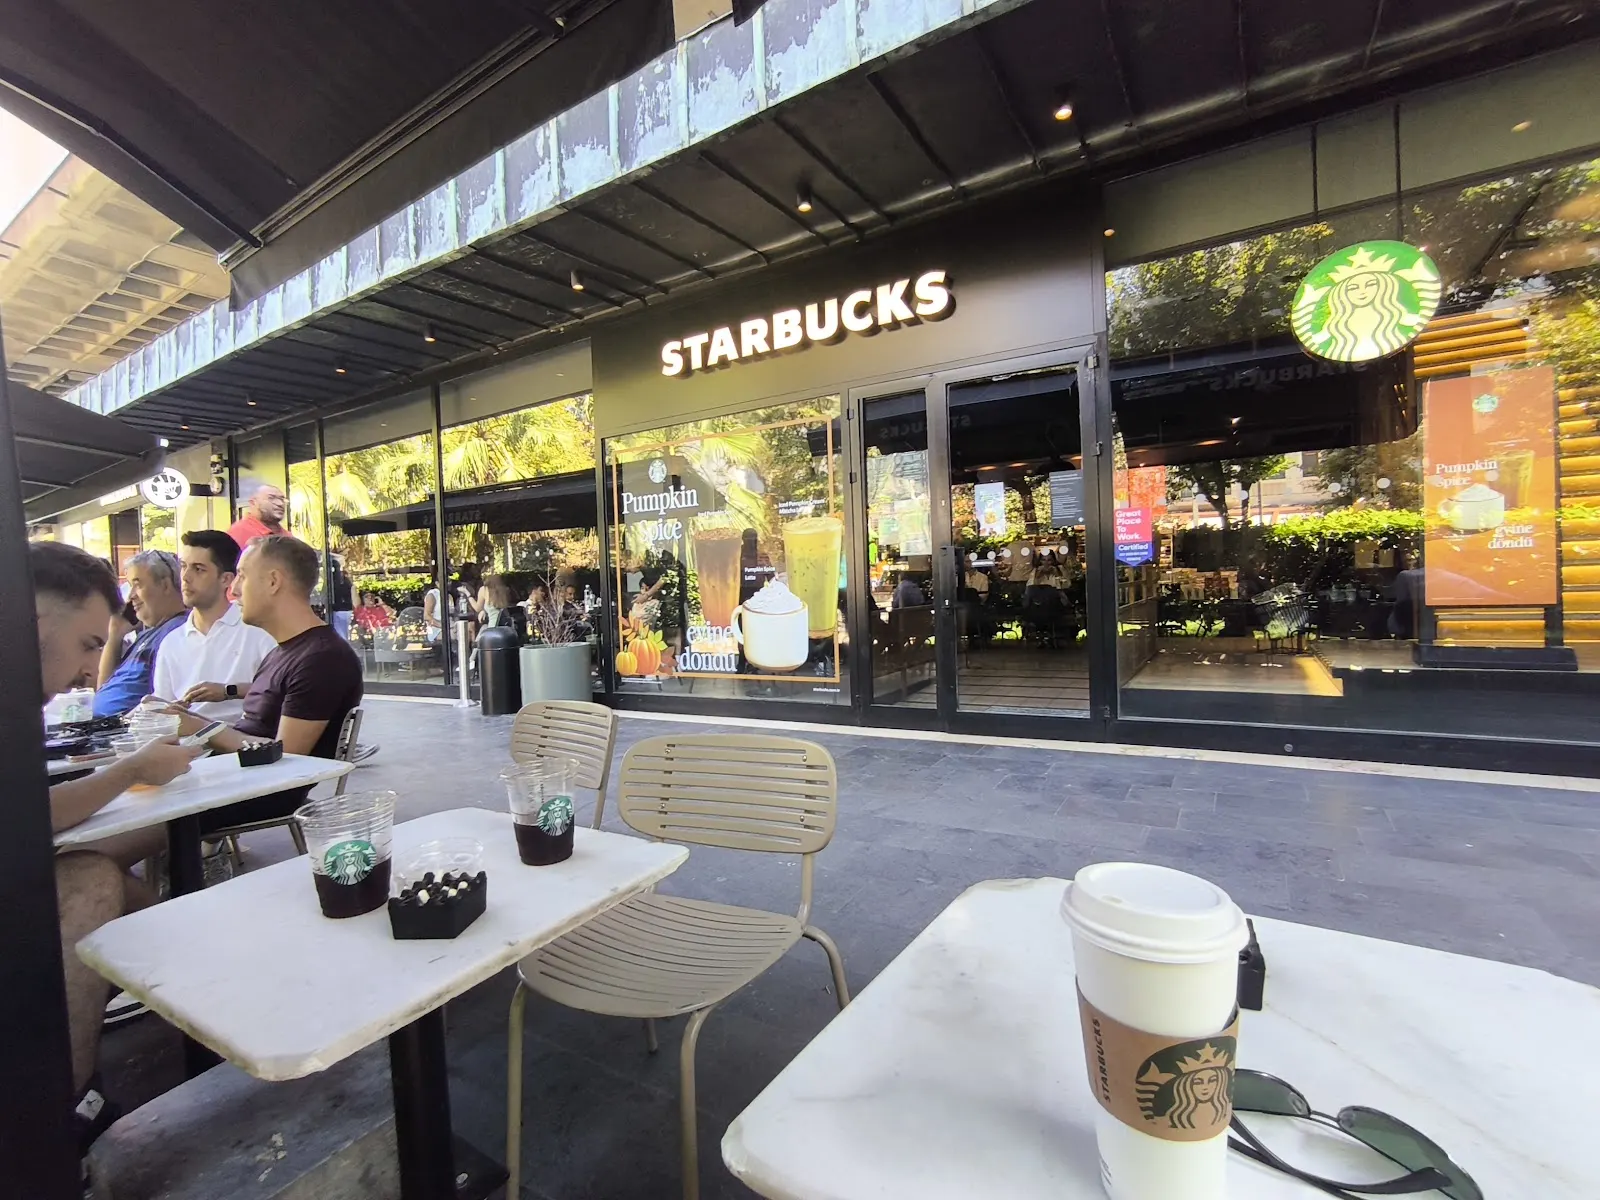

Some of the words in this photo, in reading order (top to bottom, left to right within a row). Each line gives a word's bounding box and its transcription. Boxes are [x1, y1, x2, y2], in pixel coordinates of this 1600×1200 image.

[660, 270, 949, 377] STARBUCKS
[1436, 459, 1498, 474] Pumpkin
[621, 485, 699, 516] Pumpkin
[1115, 510, 1142, 518] Great
[1116, 517, 1142, 525] Place
[639, 518, 682, 546] Spice
[1115, 525, 1127, 533] To
[1118, 543, 1148, 551] Certified
[1092, 1018, 1111, 1103] STARBUCKS
